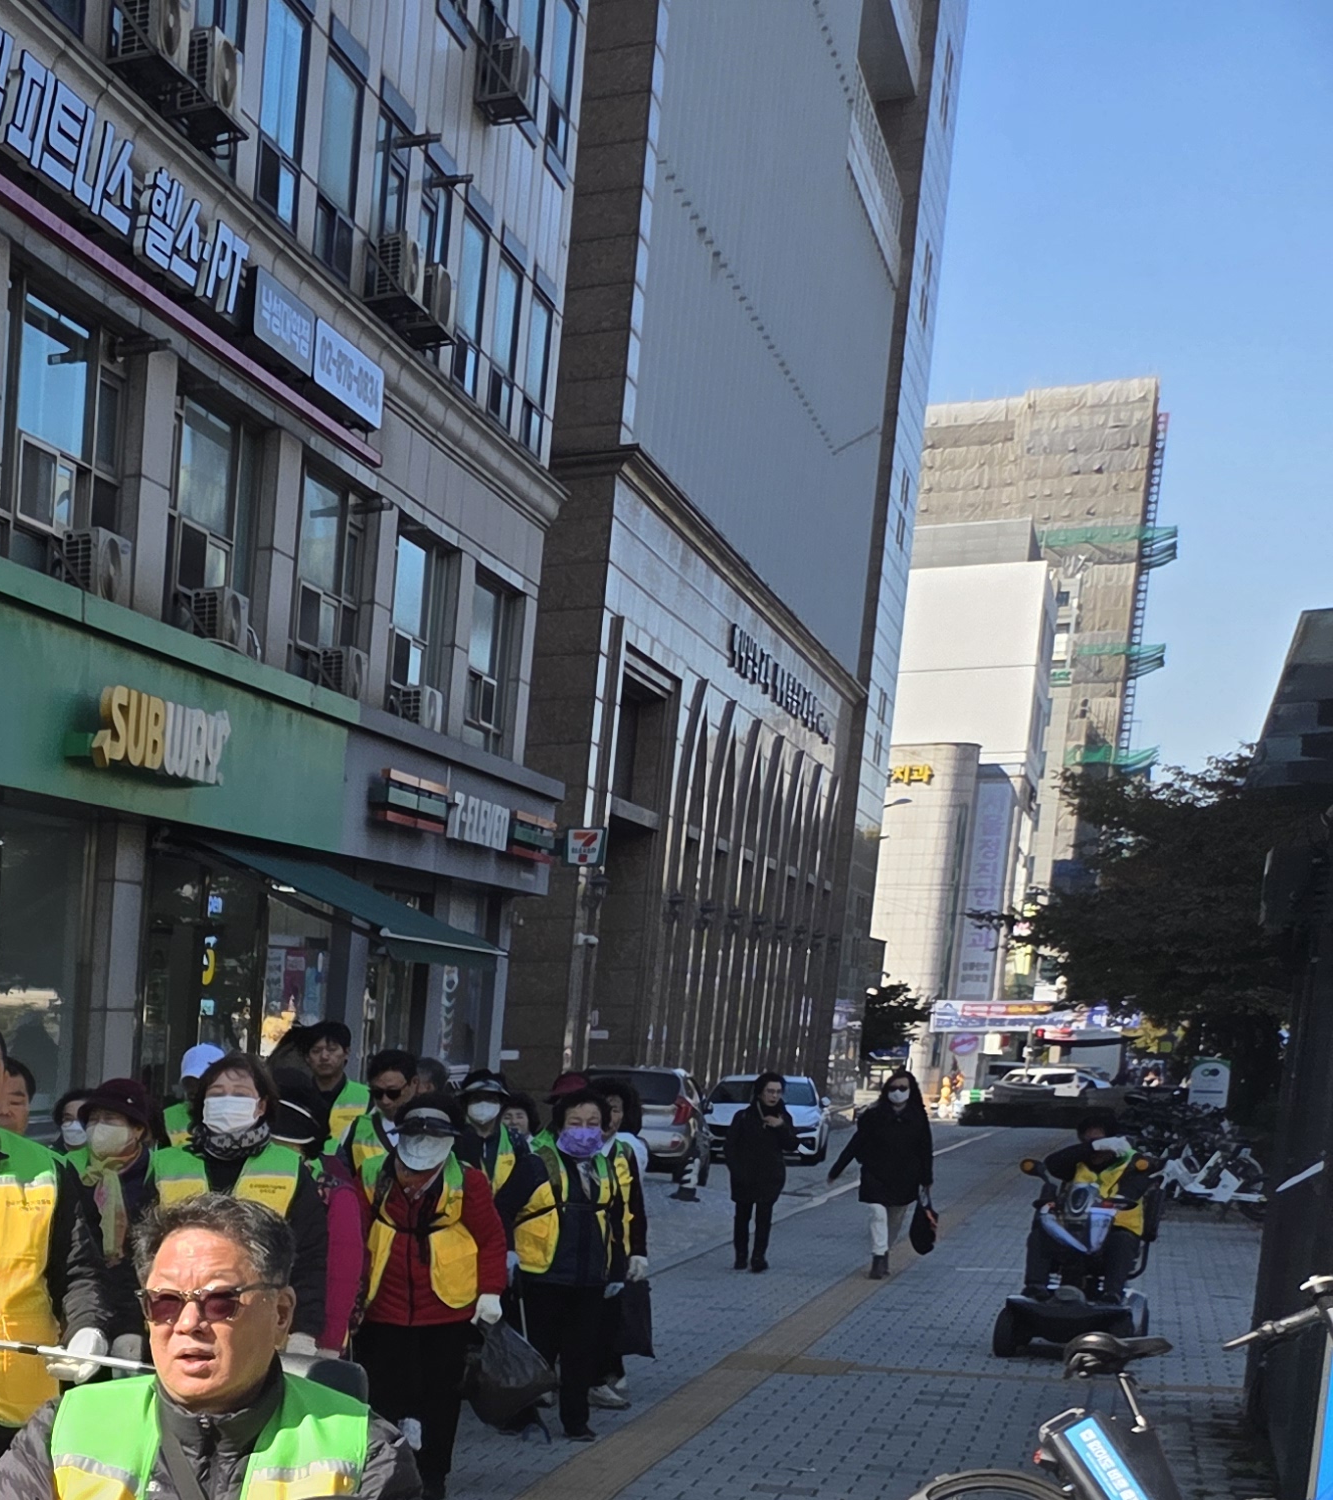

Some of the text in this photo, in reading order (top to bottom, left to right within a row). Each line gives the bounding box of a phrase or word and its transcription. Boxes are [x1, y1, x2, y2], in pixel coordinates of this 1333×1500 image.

[5, 48, 134, 236] 피트니스
[92, 685, 231, 786] SUBWAY
[891, 764, 933, 786] 치과
